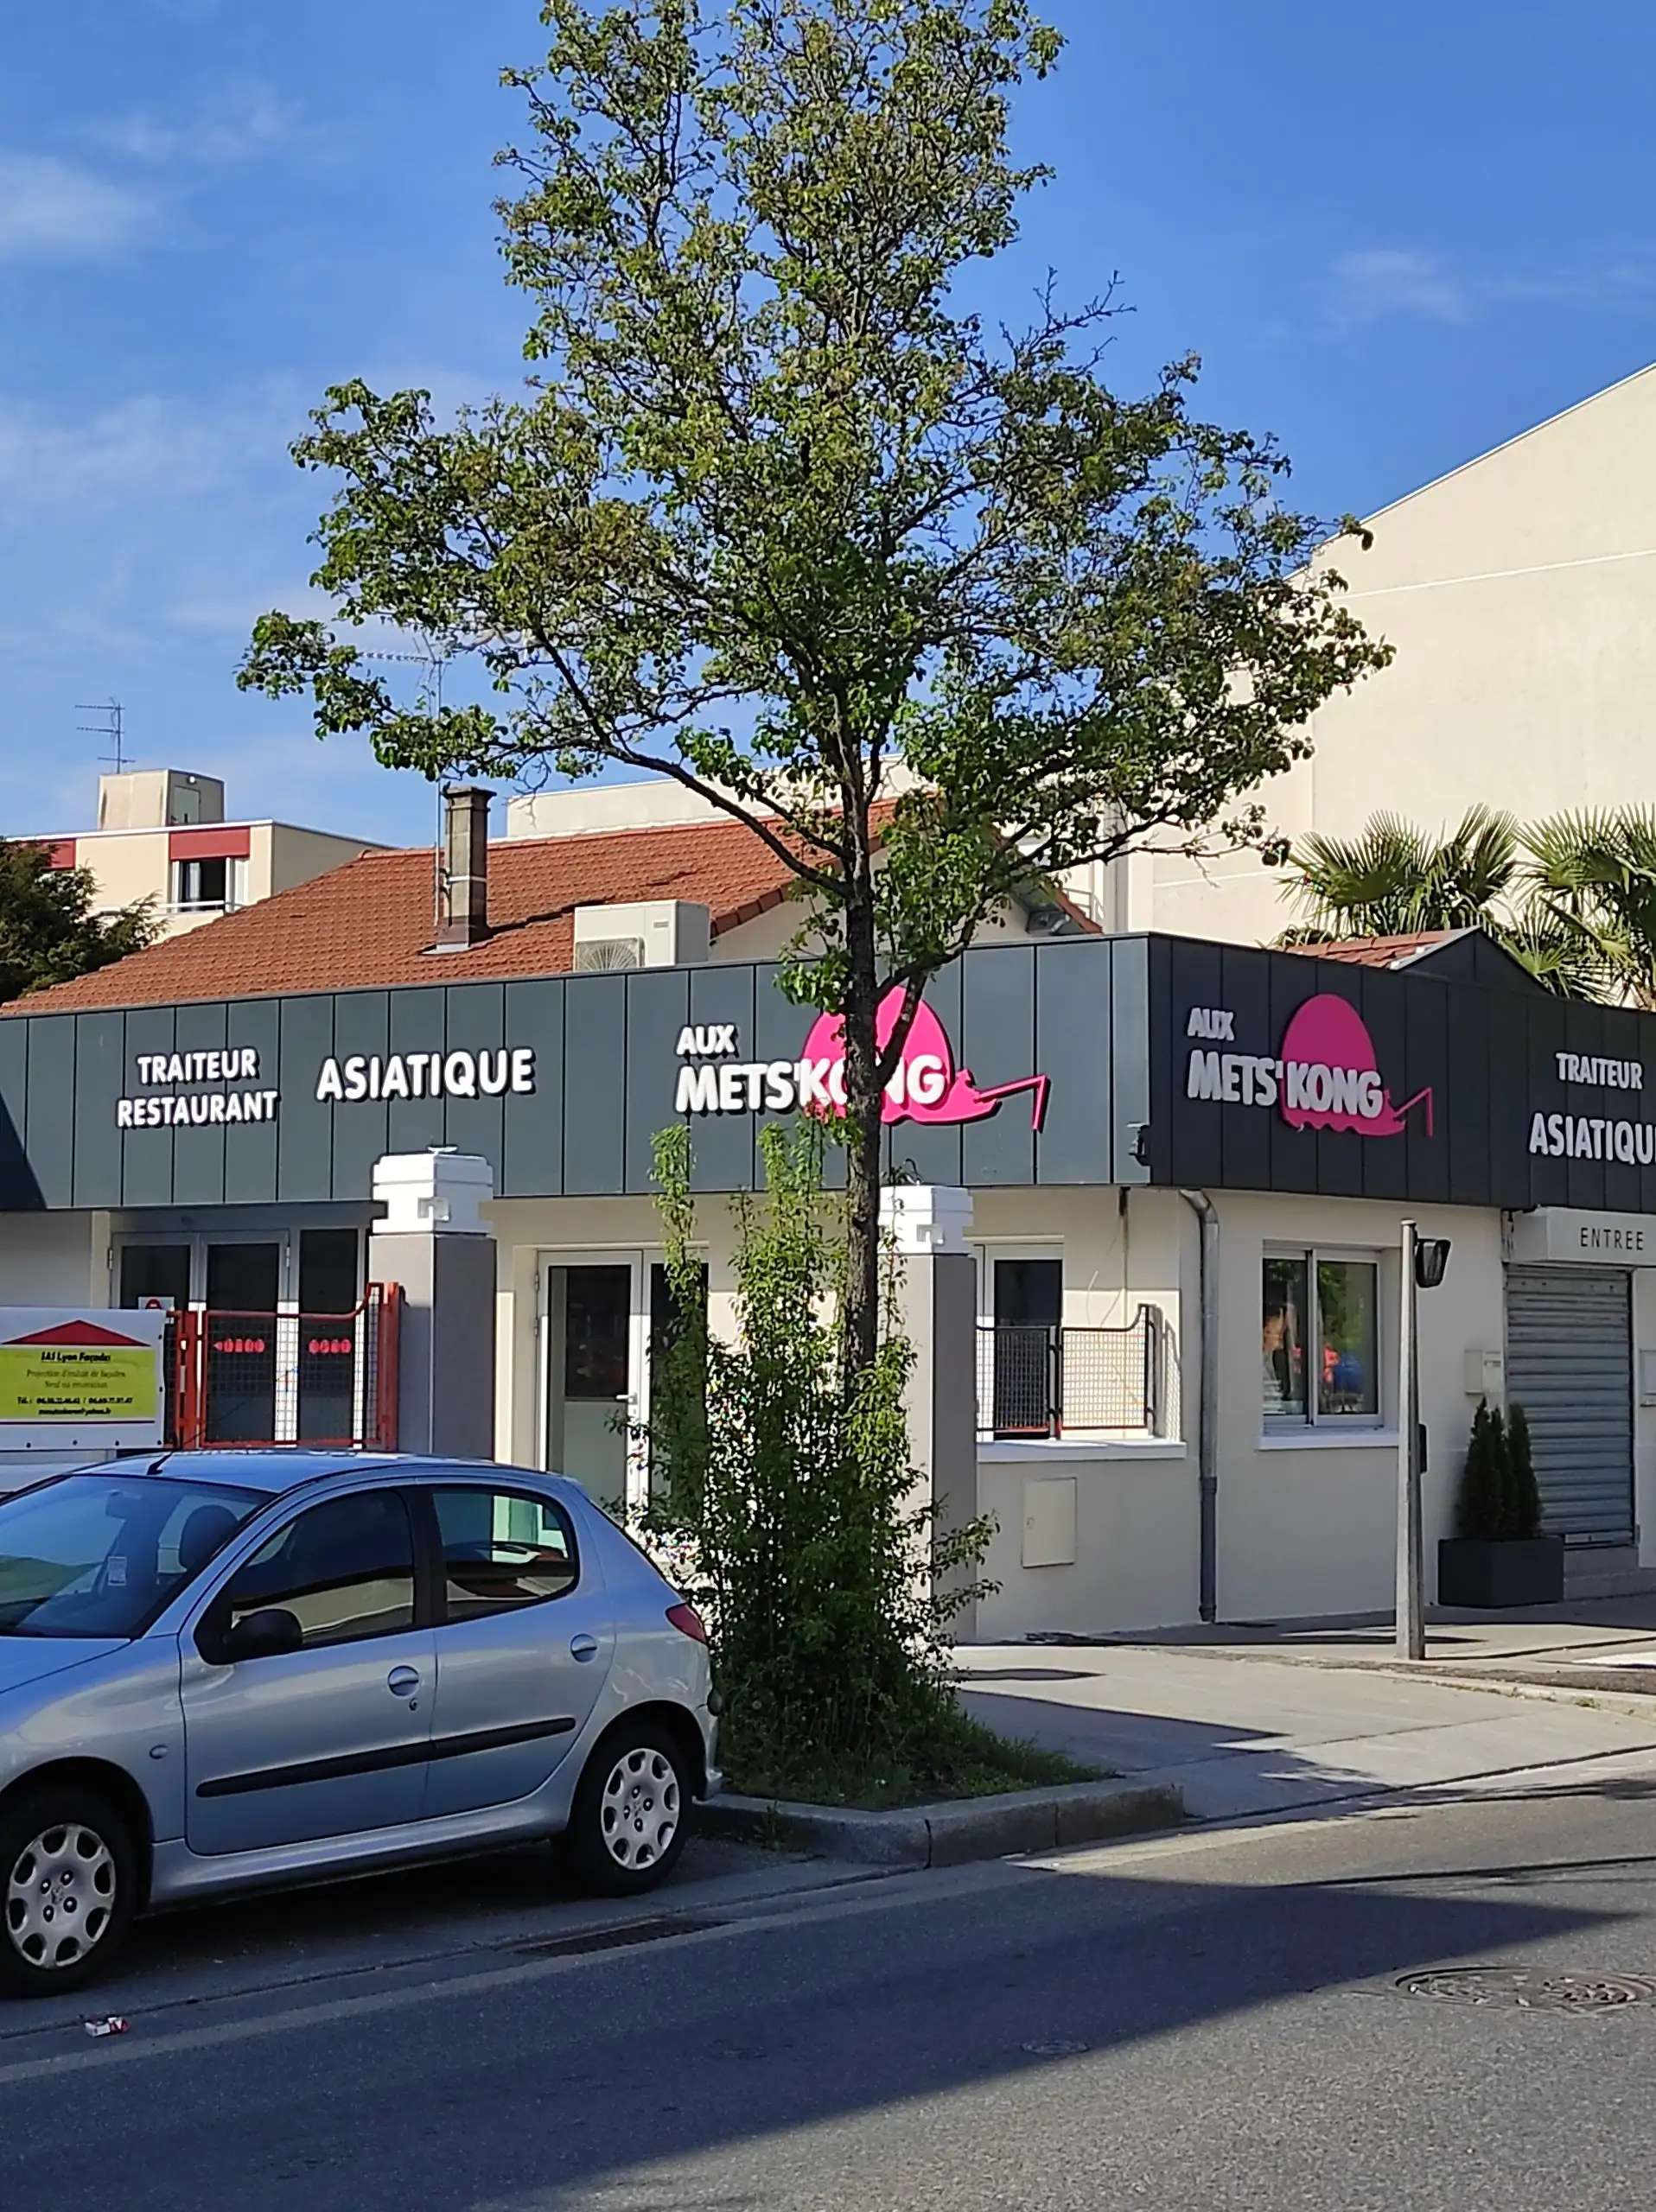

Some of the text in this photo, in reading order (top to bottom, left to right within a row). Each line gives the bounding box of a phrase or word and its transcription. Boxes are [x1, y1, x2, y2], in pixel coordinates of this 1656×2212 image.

[675, 1024, 736, 1055] AUX
[1187, 1007, 1235, 1041] AUX
[137, 1048, 258, 1085] TRAITEUR
[316, 1048, 536, 1101] ASIATIQUE
[1555, 1052, 1643, 1090] TRAITEUR
[117, 1090, 278, 1128] RESTAURANT
[1529, 1112, 1656, 1165] ASIATIQU
[1580, 1227, 1644, 1251] ENTREE
